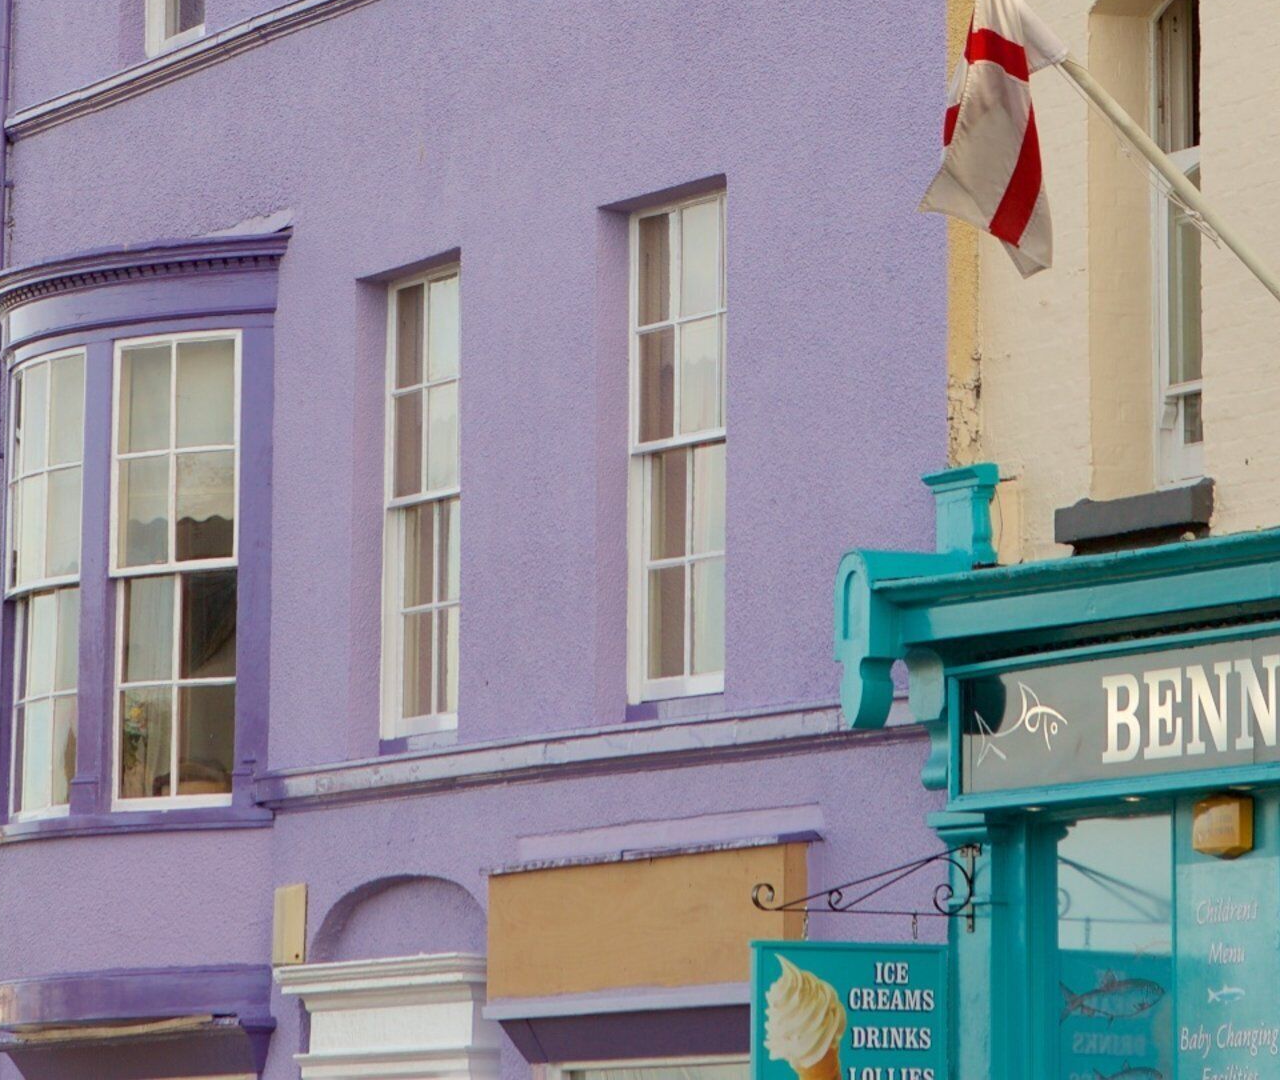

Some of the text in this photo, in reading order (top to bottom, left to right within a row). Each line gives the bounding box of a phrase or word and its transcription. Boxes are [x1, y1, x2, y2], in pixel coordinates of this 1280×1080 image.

[1196, 897, 1258, 925] Children's
[1208, 941, 1246, 965] Menu
[874, 961, 909, 985] ICE
[848, 987, 936, 1012] CREAMS
[851, 1026, 932, 1050] DRINKS
[1179, 1021, 1280, 1059] Baby Changing
